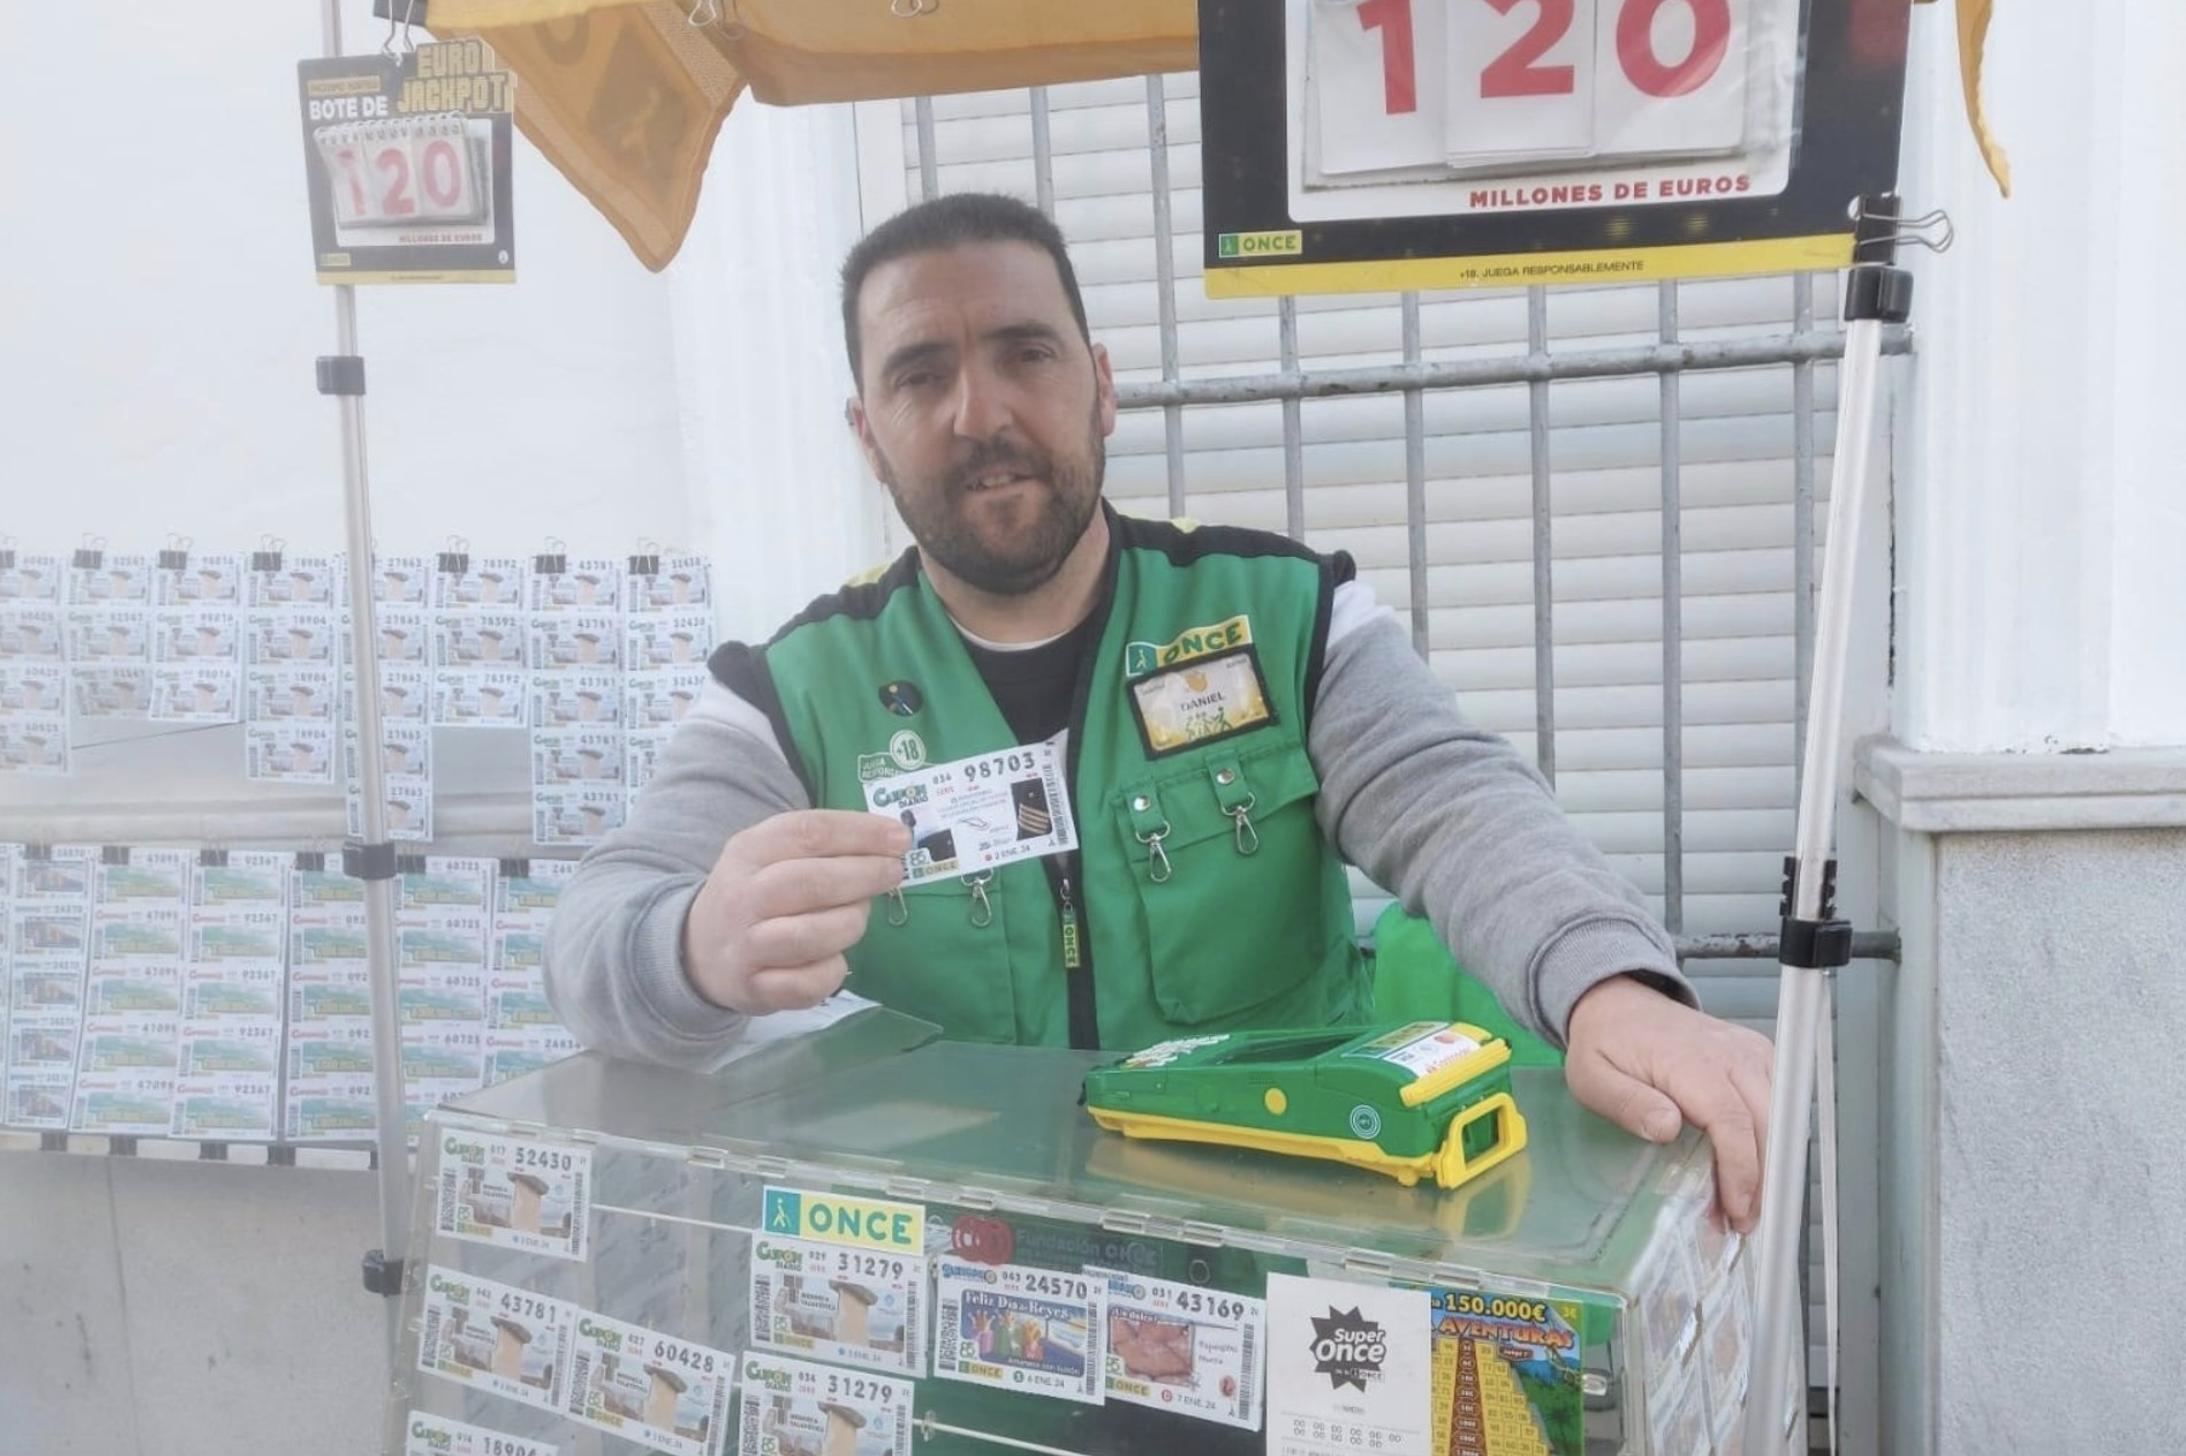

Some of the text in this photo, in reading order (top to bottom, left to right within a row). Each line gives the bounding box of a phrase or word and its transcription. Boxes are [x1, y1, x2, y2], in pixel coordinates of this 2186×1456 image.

[416, 40, 481, 78] EURO
[1355, 0, 1731, 115] 120
[309, 95, 389, 120] BOTE DE
[396, 76, 507, 113] JACKPOT
[336, 140, 463, 215] 120
[1469, 174, 1750, 209] MILLONES DE EUROS
[1242, 236, 1297, 252] ONCE
[1481, 266, 1519, 279] JUEGA
[1521, 258, 1645, 277] RESPONSABLEMENTE
[1163, 621, 1243, 665] ONCE
[1180, 690, 1225, 712] DANIEL
[896, 739, 920, 762] +18
[963, 750, 1036, 784] 98703
[926, 861, 958, 875] ONCE
[1065, 926, 1077, 964] ONCE
[515, 1146, 572, 1171] 52430
[808, 1203, 914, 1245] ONCE
[838, 1252, 904, 1281] 31279
[1025, 1273, 1088, 1300] 24570
[500, 1292, 557, 1325] 43781
[965, 1291, 995, 1309] Feliz
[1029, 1300, 1070, 1322] Reyes
[1176, 1290, 1244, 1321] 43169
[1445, 1293, 1547, 1322] 150.000€
[1562, 1305, 1578, 1320] 3€
[1335, 1327, 1387, 1346] Super
[1439, 1315, 1576, 1350] AVENTURAS
[654, 1340, 715, 1374] 60428
[1315, 1337, 1386, 1364] Once
[970, 1362, 1004, 1379] ONCE
[827, 1374, 893, 1404] 31279
[1115, 1381, 1149, 1397] ONCE
